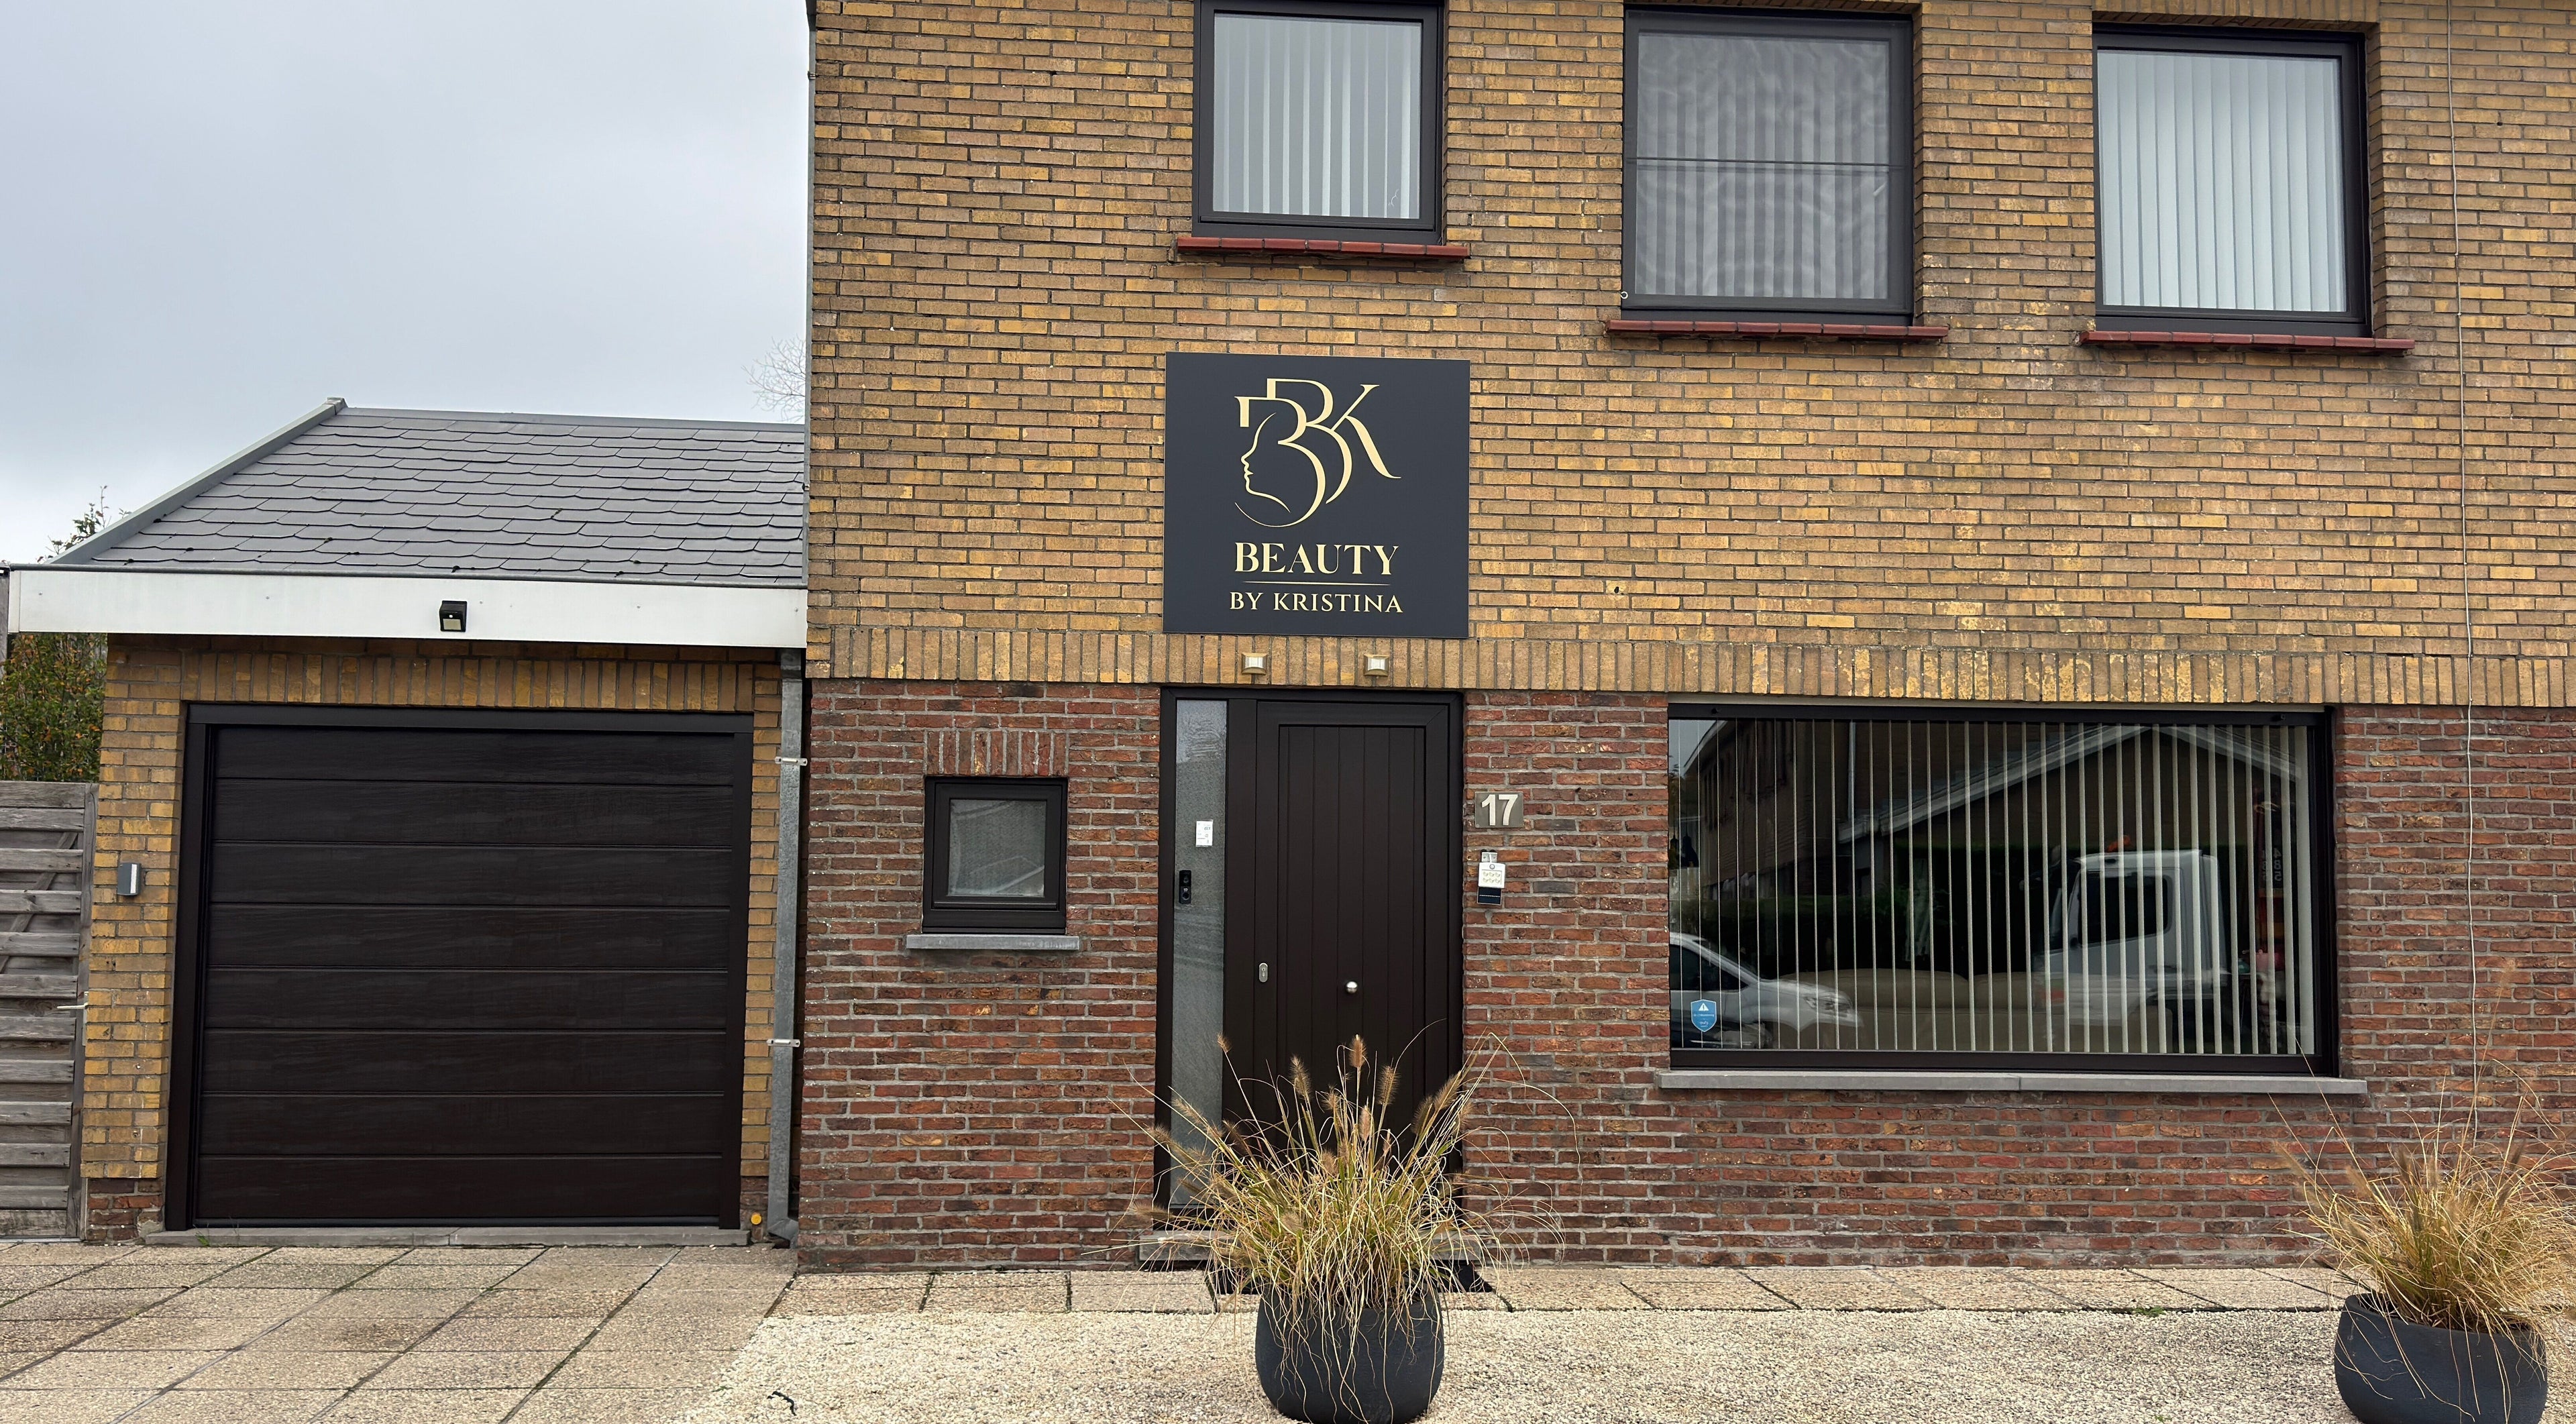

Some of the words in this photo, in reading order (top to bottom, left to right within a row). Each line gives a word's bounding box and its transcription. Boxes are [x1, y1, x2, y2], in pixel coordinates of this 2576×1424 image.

[1234, 542, 1399, 576] BEAUTY
[1230, 592, 1264, 610] BY
[1273, 593, 1403, 613] KRISTINA
[1481, 793, 1518, 826] 17
